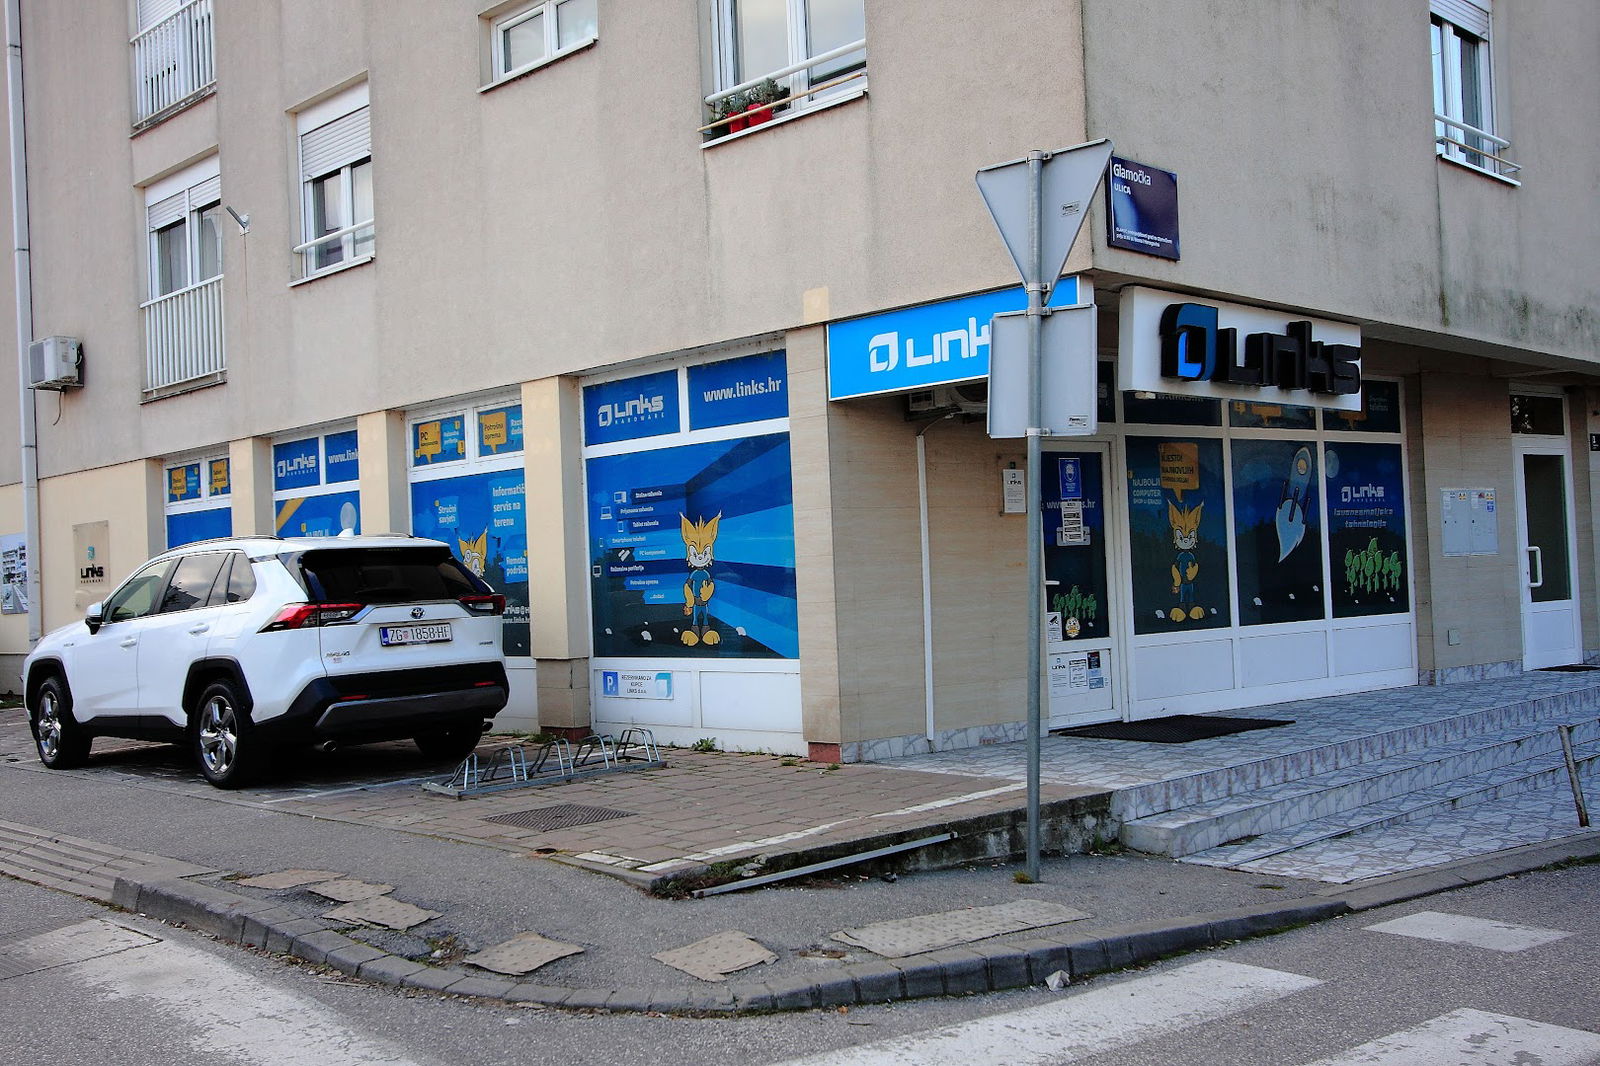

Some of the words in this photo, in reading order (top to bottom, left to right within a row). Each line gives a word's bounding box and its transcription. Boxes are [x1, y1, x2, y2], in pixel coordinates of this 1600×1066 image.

[1113, 163, 1152, 186] Glamočka
[1114, 182, 1132, 195] ULICA
[703, 376, 782, 403] www.links.hr
[420, 431, 429, 441] PC
[493, 501, 513, 513] servis
[512, 502, 521, 510] na
[494, 517, 515, 528] terenu
[389, 628, 403, 643] ZG
